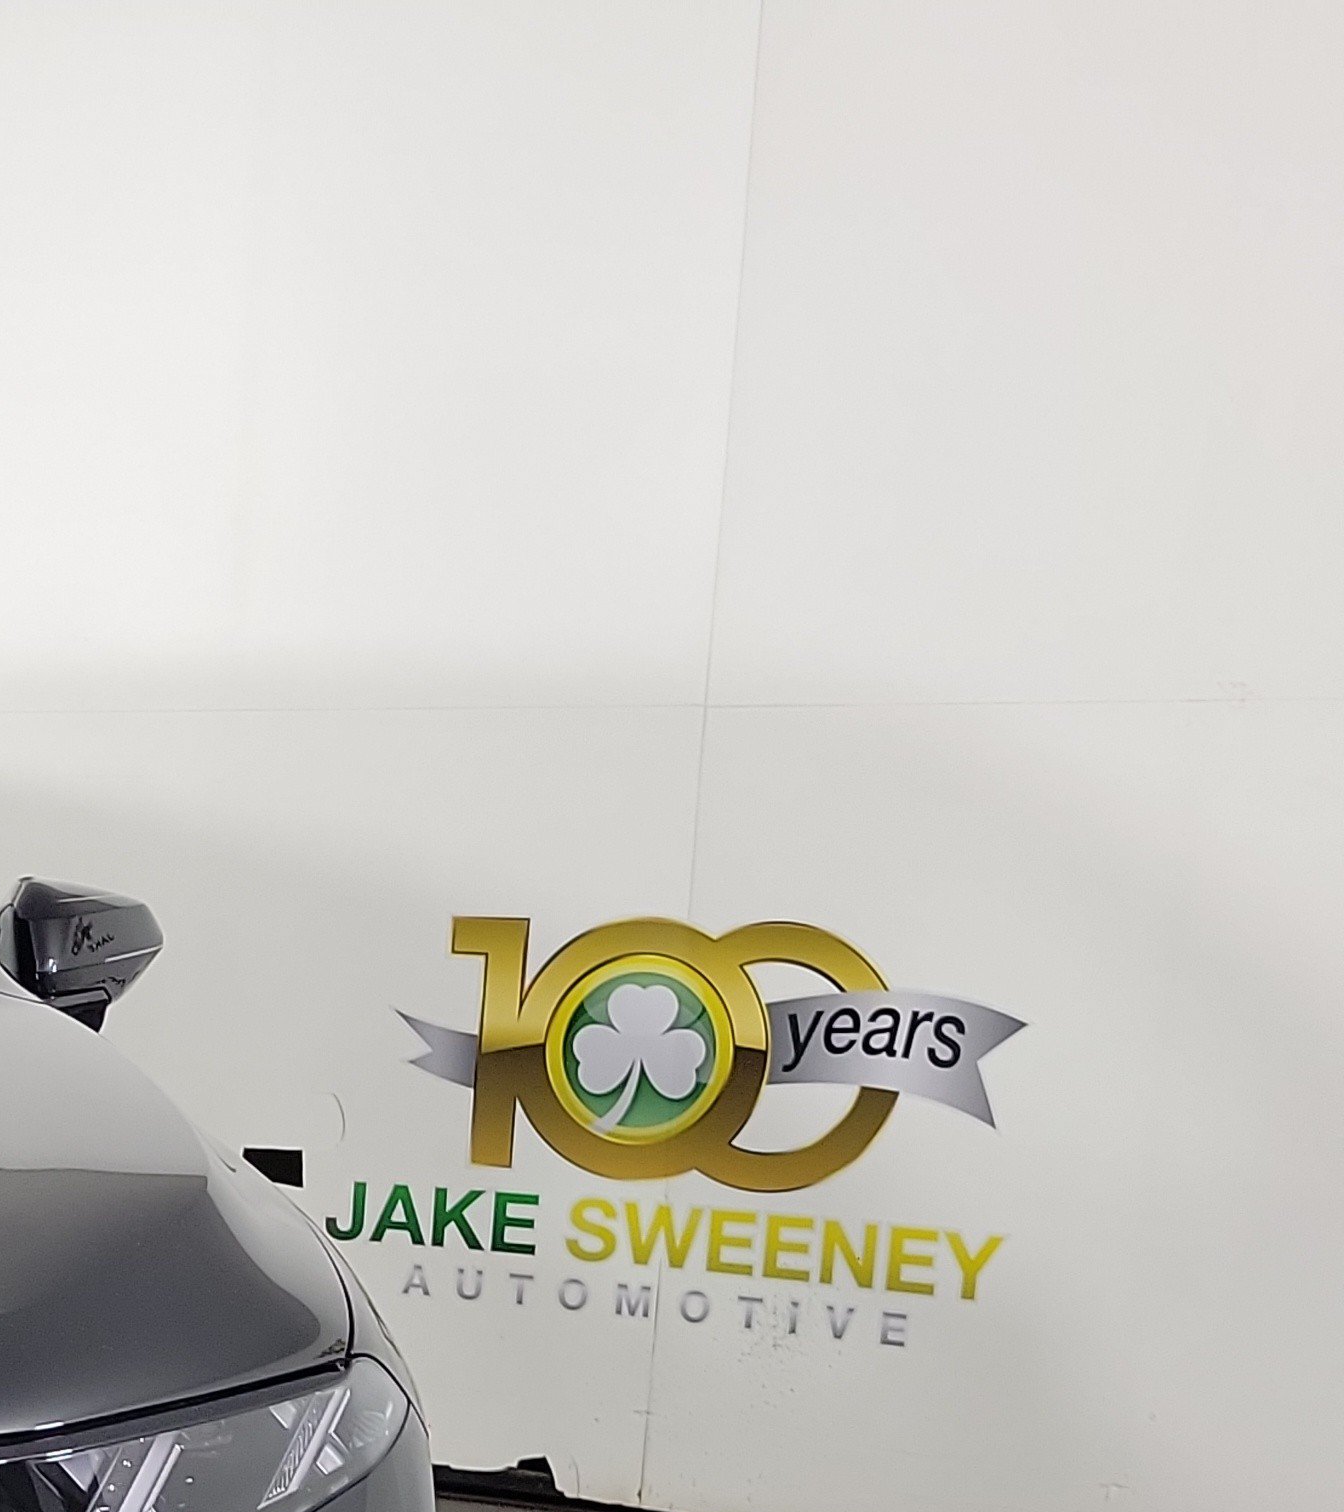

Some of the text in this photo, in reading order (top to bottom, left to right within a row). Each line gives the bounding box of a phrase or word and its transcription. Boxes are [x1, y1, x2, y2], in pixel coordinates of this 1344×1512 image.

[451, 916, 968, 1192] 100 years
[324, 1180, 1005, 1301] JAKE SWEENEY
[402, 1264, 909, 1348] AUTOMOTIVE
